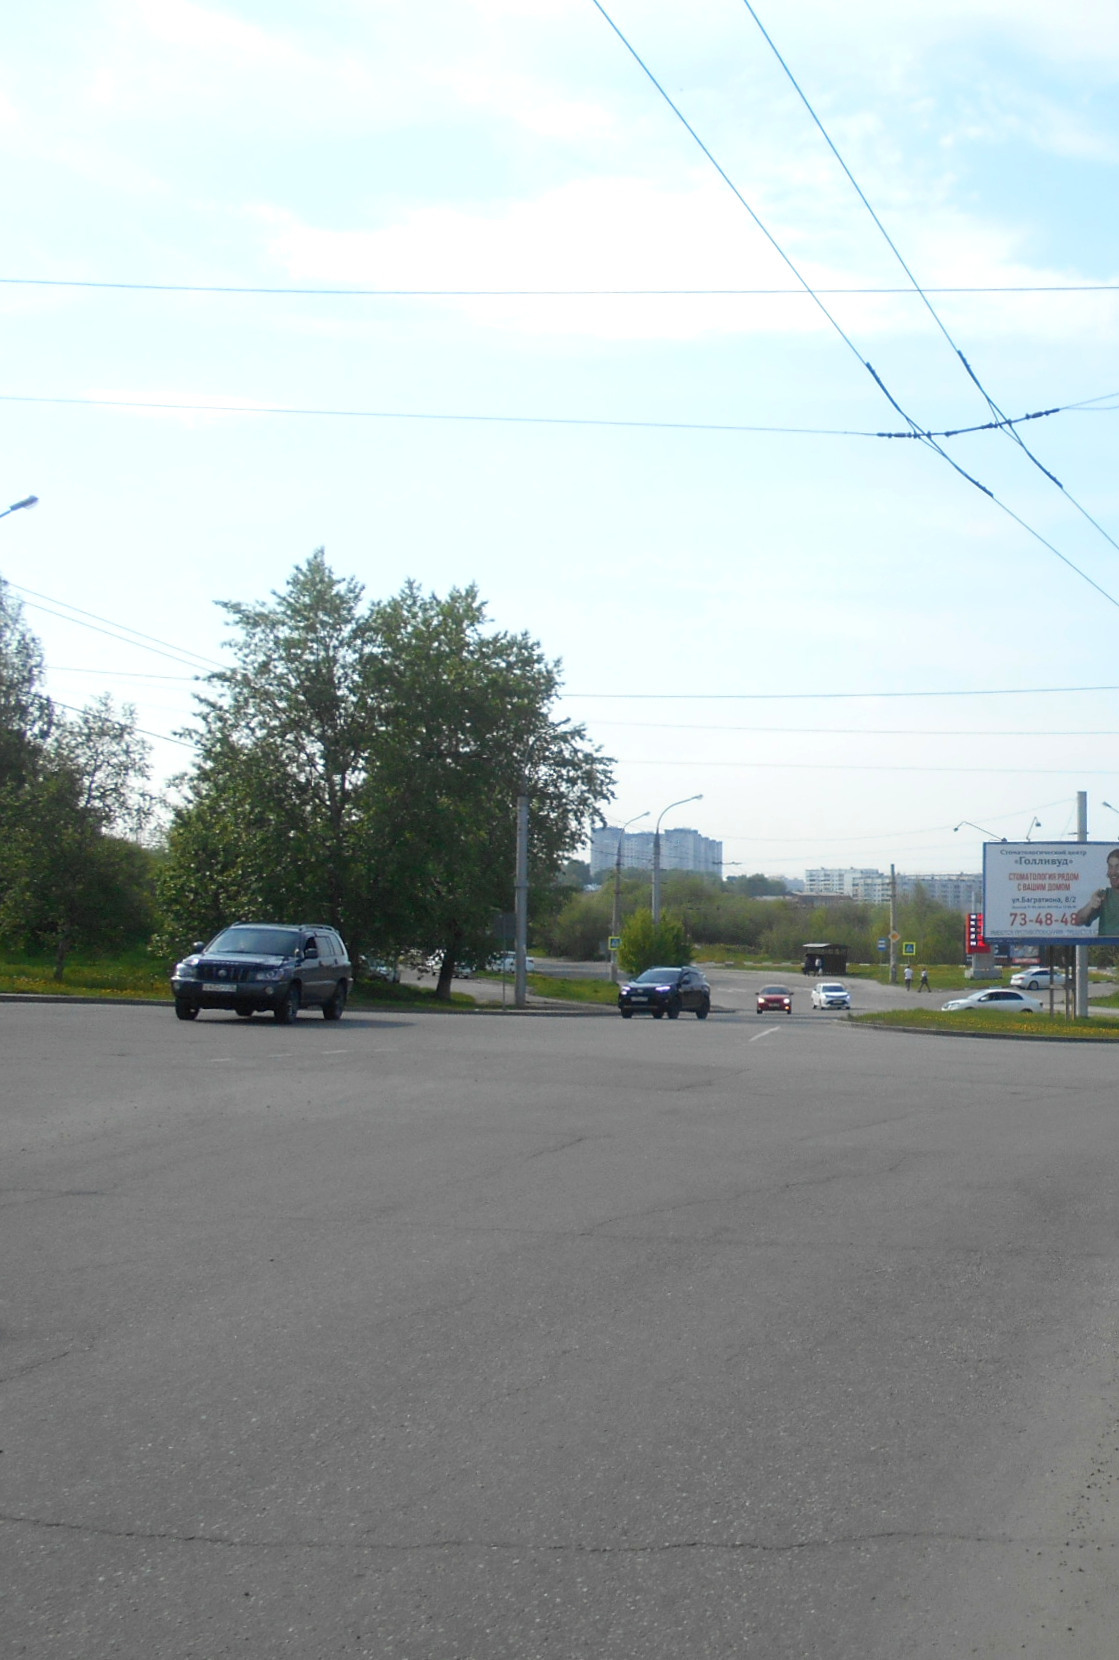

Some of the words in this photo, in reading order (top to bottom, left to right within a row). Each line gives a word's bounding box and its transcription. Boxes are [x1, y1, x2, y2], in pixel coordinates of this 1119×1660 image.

[1008, 872, 1057, 881] СТОМАТОЛОГИЯ
[1057, 872, 1080, 881] РЯДОМ
[1022, 883, 1046, 891] ВАШИМ
[1047, 883, 1071, 891] ДОМОМ
[1009, 912, 1079, 926] 73-48-48
